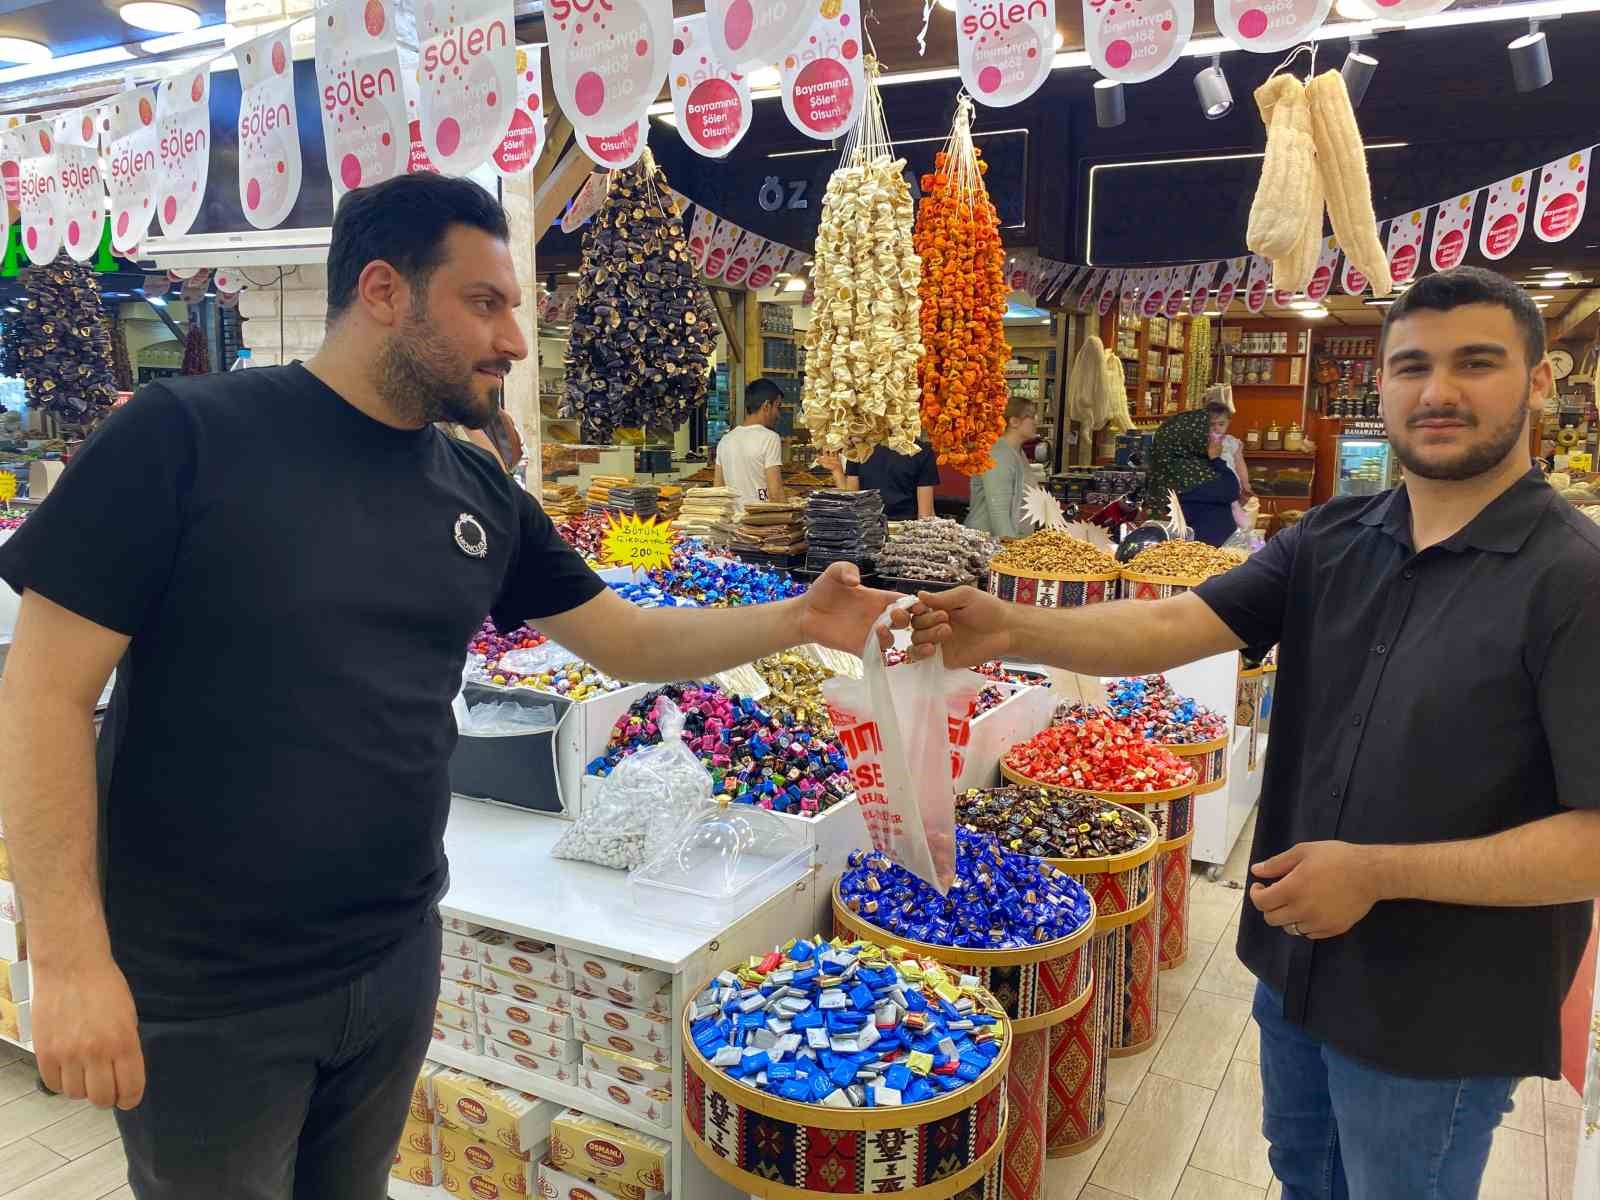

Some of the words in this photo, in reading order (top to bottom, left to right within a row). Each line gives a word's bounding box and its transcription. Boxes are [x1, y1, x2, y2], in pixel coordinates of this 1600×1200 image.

[795, 77, 849, 97] Bayramınız
[688, 97, 739, 115] Bayramınız
[809, 94, 838, 109] Şölen
[703, 112, 728, 127] Şölen
[759, 175, 808, 211] ÖZ
